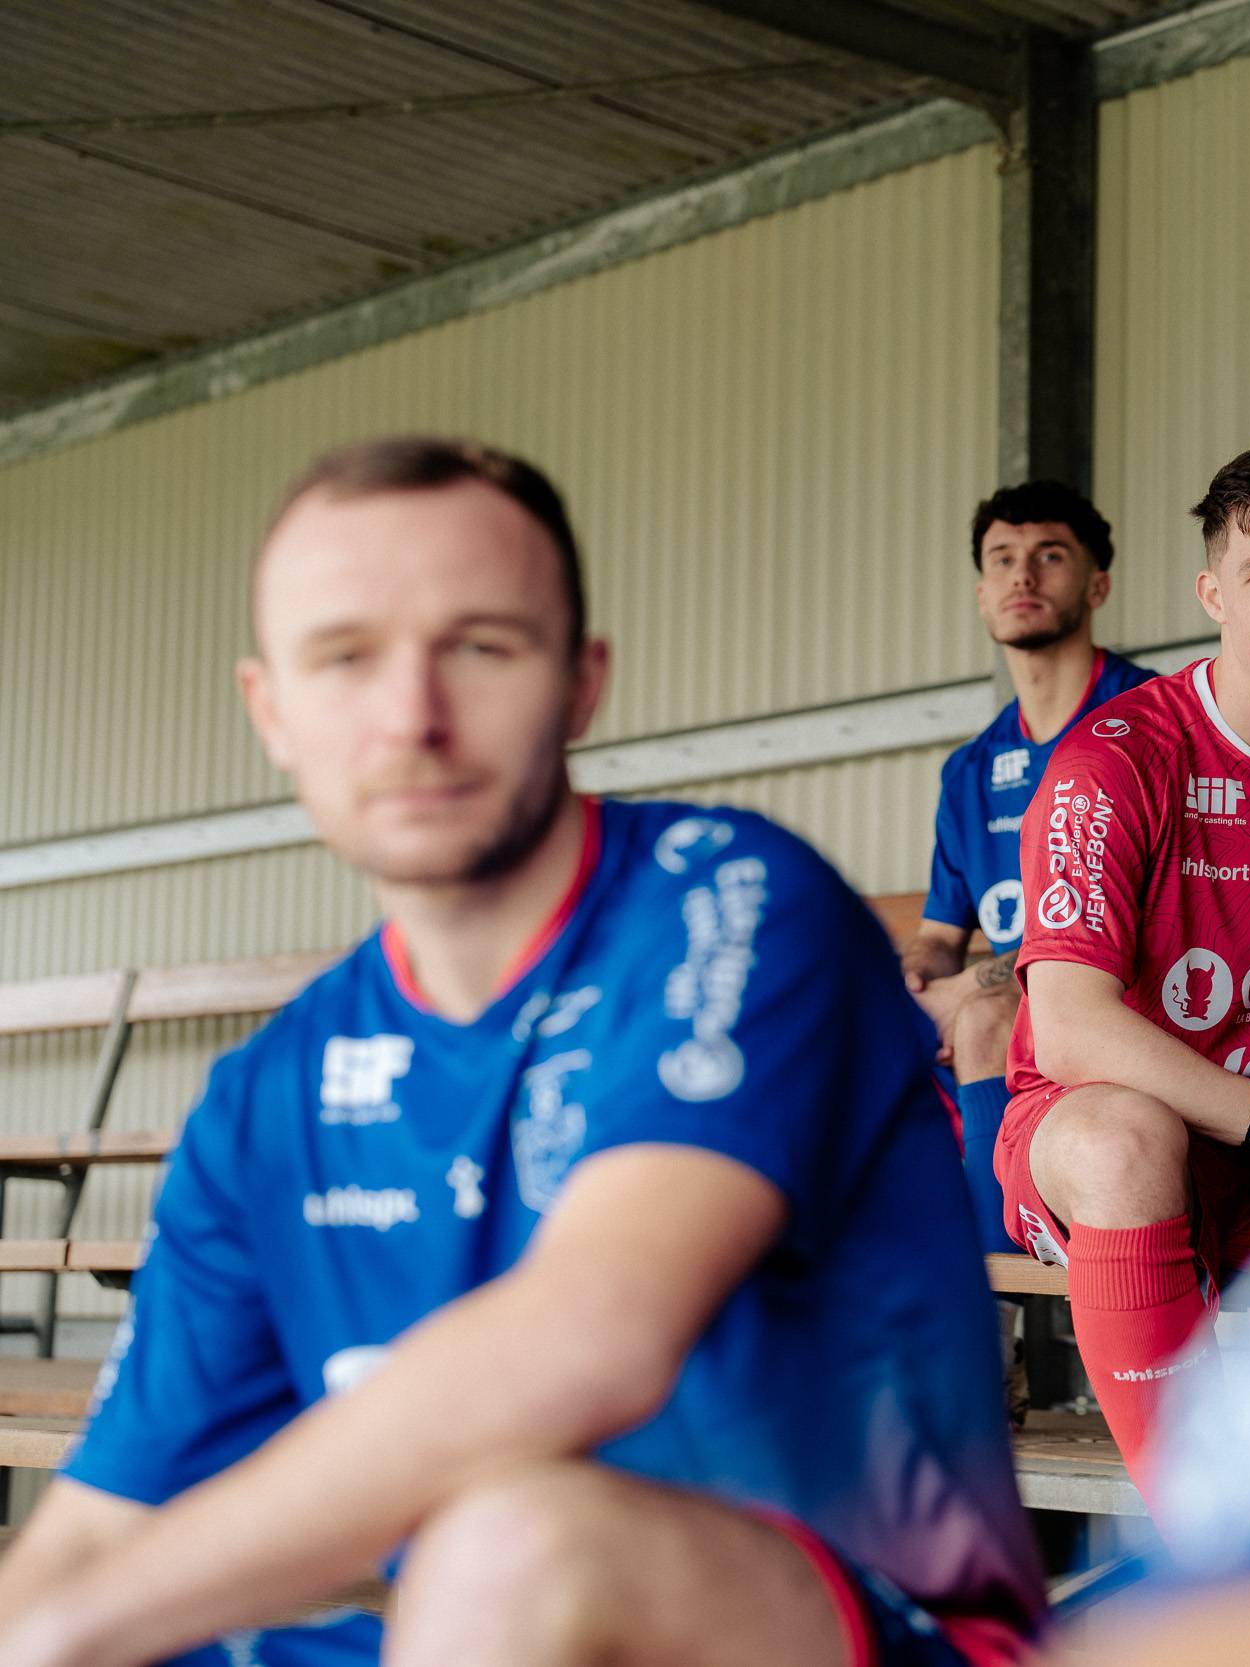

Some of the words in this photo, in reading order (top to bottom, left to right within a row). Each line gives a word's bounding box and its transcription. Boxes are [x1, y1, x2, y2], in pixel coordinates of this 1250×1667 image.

[1085, 788, 1115, 933] HENNEBONT
[1204, 817, 1233, 827] casting
[1234, 817, 1247, 826] fits
